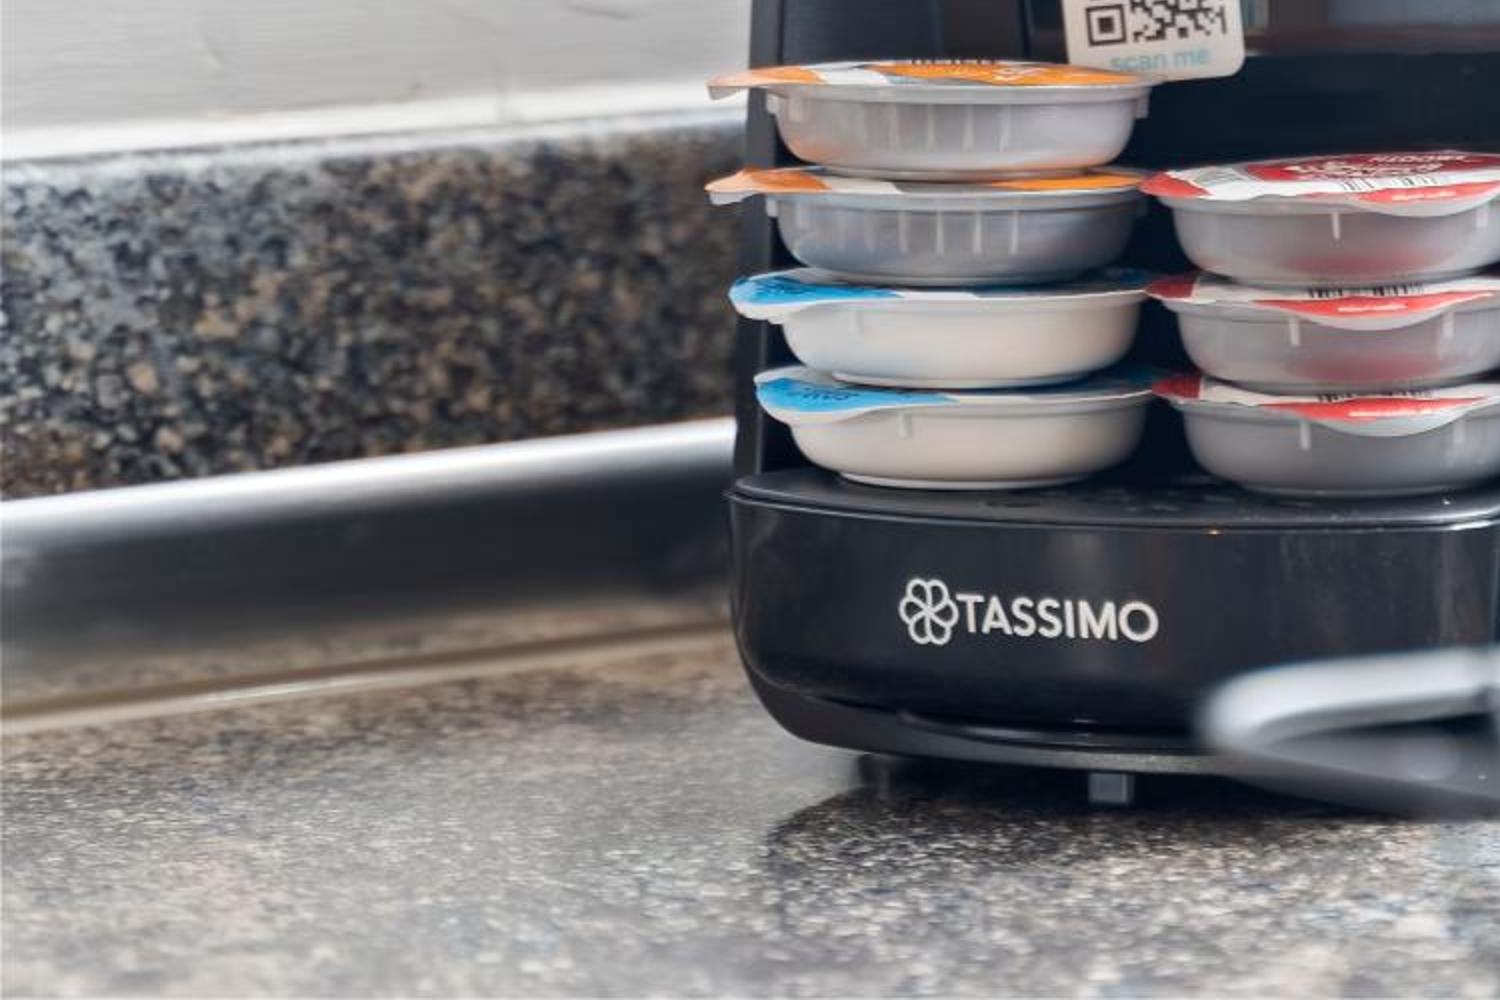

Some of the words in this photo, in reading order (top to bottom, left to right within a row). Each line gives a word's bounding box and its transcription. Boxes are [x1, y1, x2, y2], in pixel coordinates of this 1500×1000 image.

[1109, 53, 1168, 73] scan
[1172, 47, 1210, 67] me
[955, 593, 1160, 642] TASSIMO
